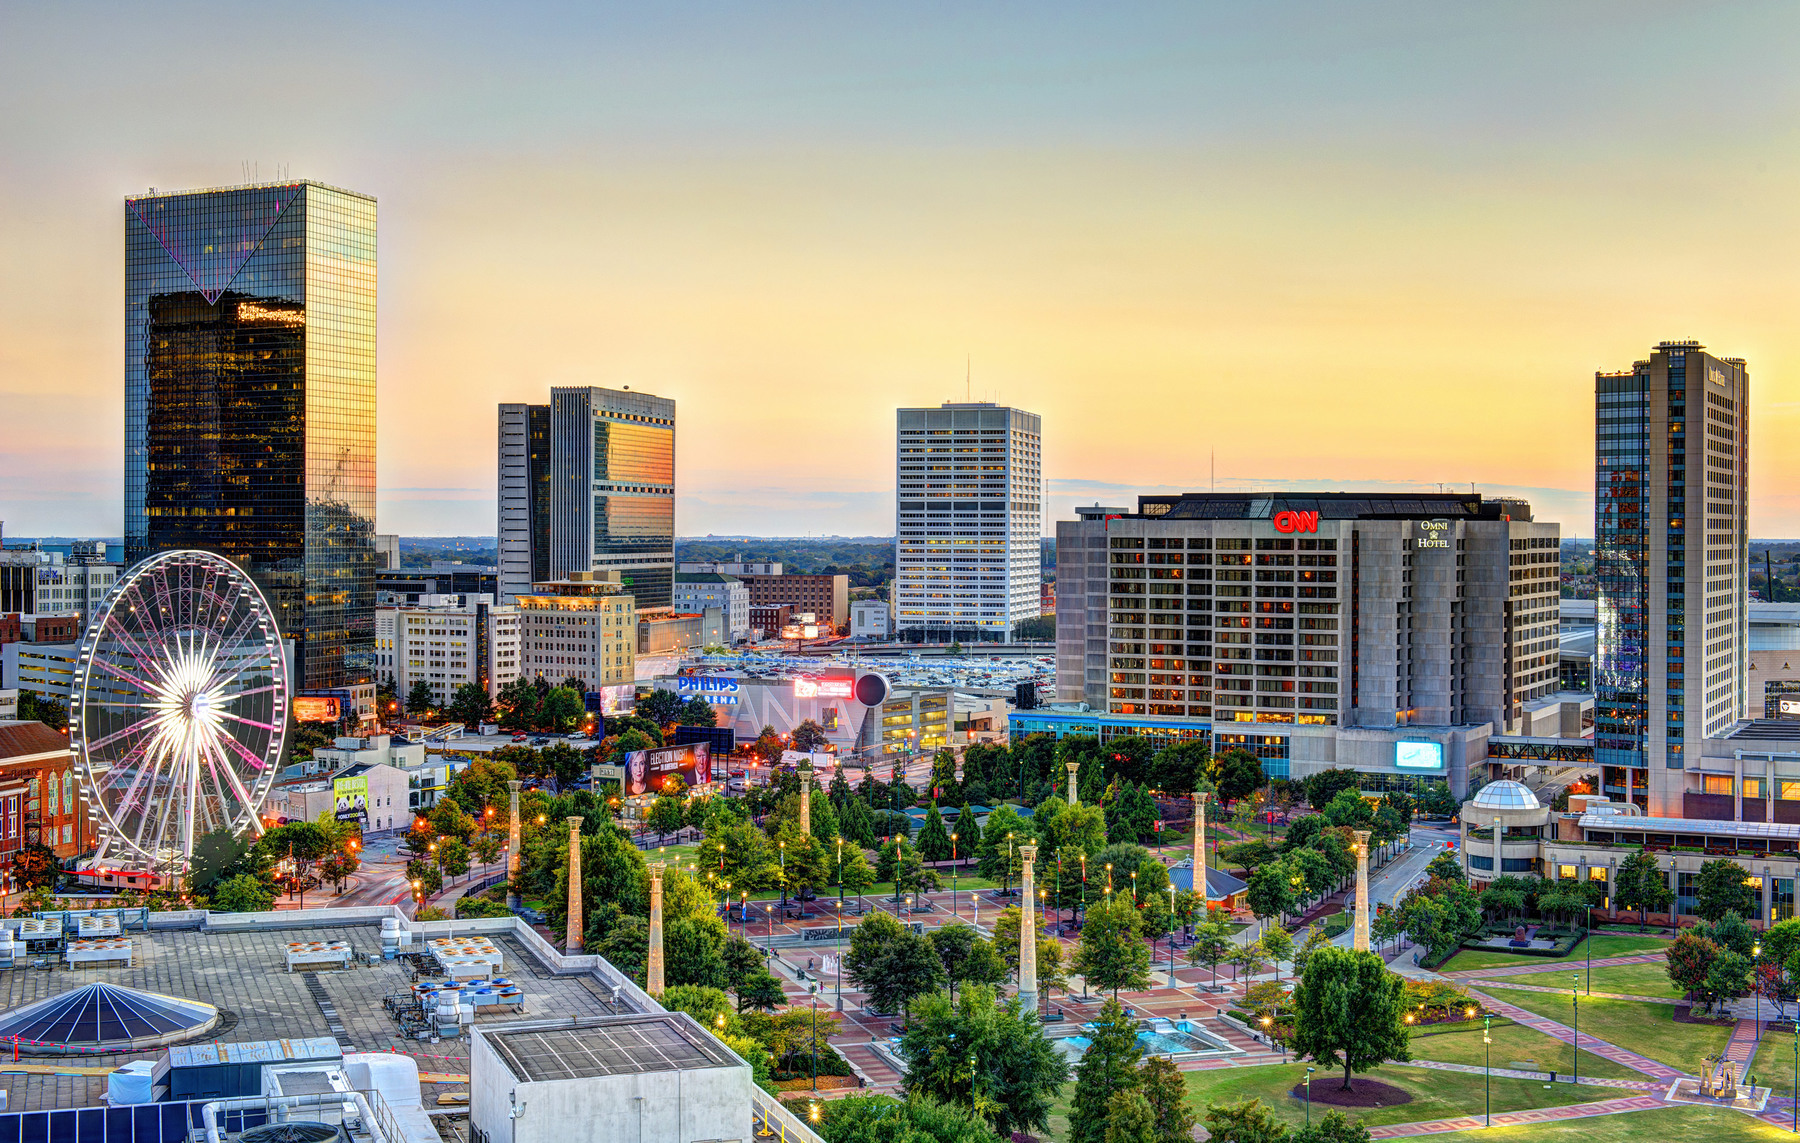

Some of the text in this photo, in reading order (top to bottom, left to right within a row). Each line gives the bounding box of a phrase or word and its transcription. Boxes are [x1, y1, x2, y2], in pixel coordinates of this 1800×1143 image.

[1273, 510, 1318, 533] CNN
[39, 567, 58, 579] telx
[678, 676, 738, 692] PHILIPS
[698, 695, 737, 704] RENA
[650, 749, 688, 765] ELECTION NIGHT
